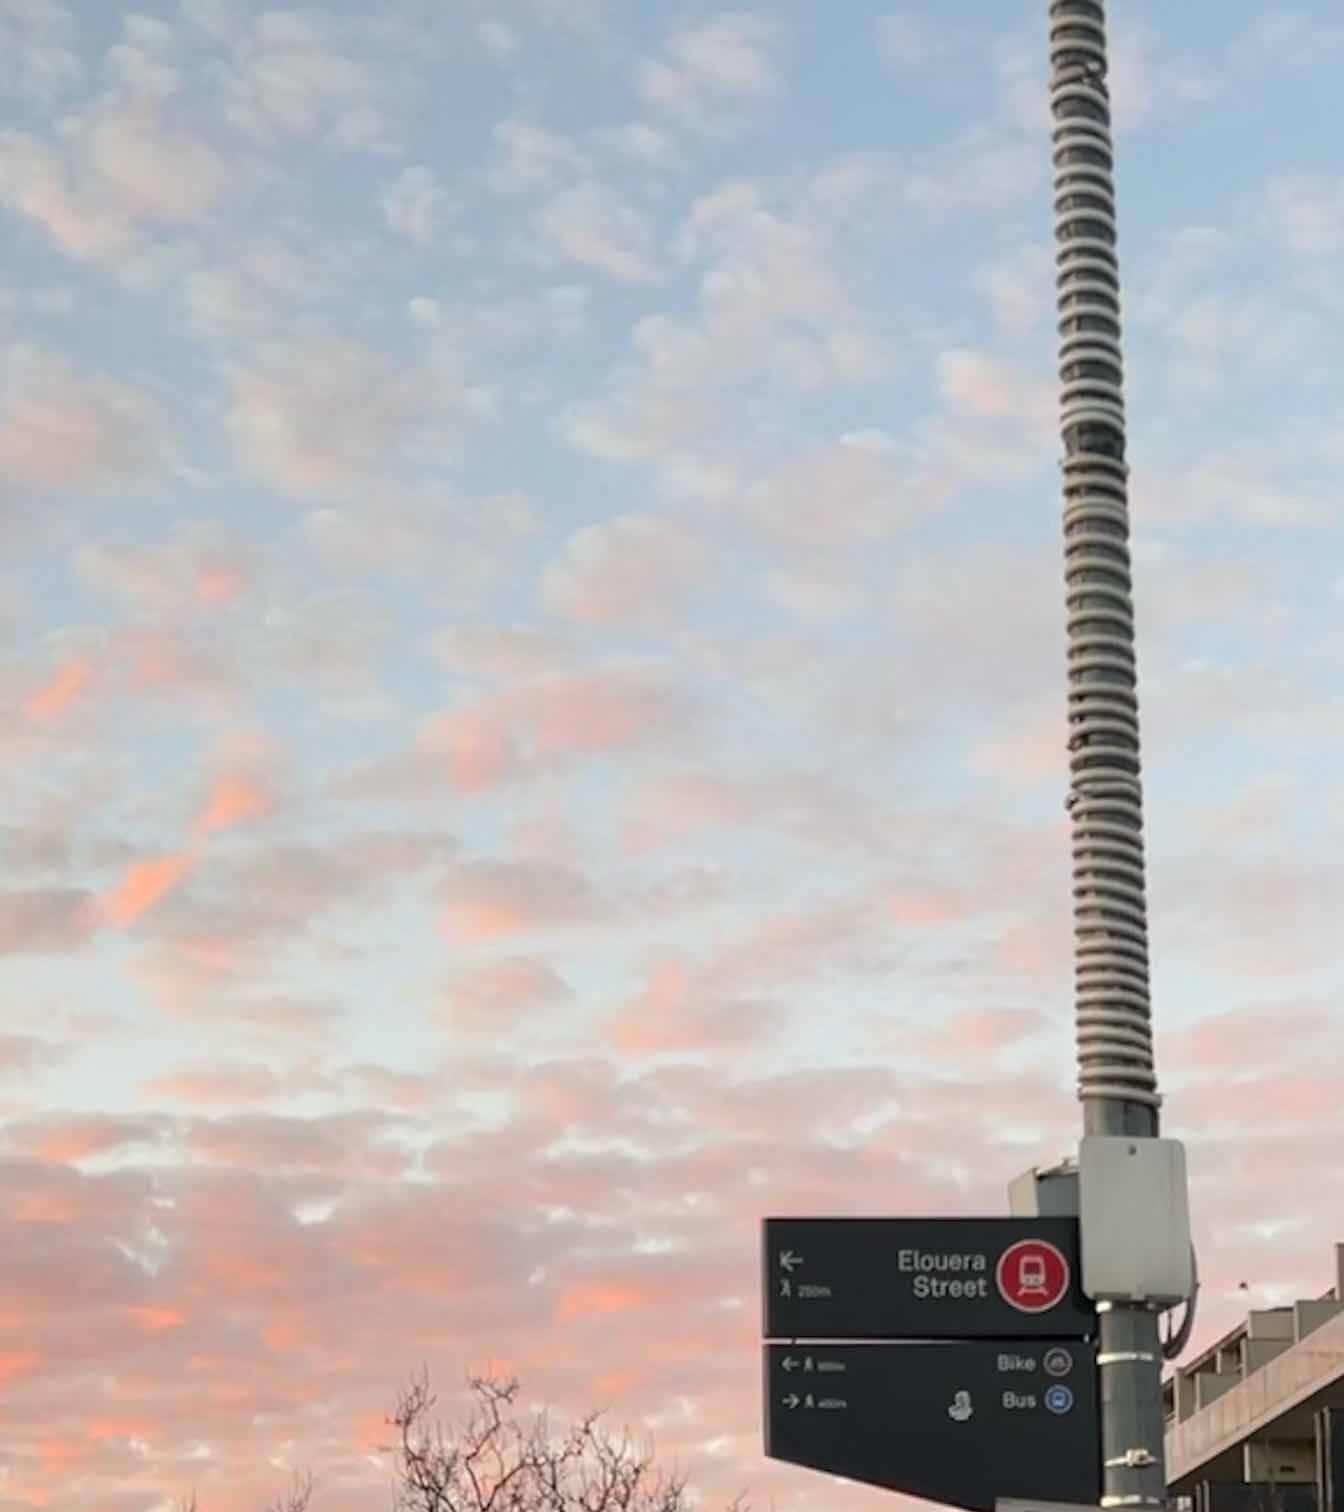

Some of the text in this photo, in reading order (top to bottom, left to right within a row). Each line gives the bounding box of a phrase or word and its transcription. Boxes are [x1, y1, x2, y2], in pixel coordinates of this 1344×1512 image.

[897, 1249, 987, 1272] Elouera
[913, 1274, 988, 1298] Street
[997, 1353, 1036, 1372] Bike
[1002, 1390, 1037, 1409] Bus
